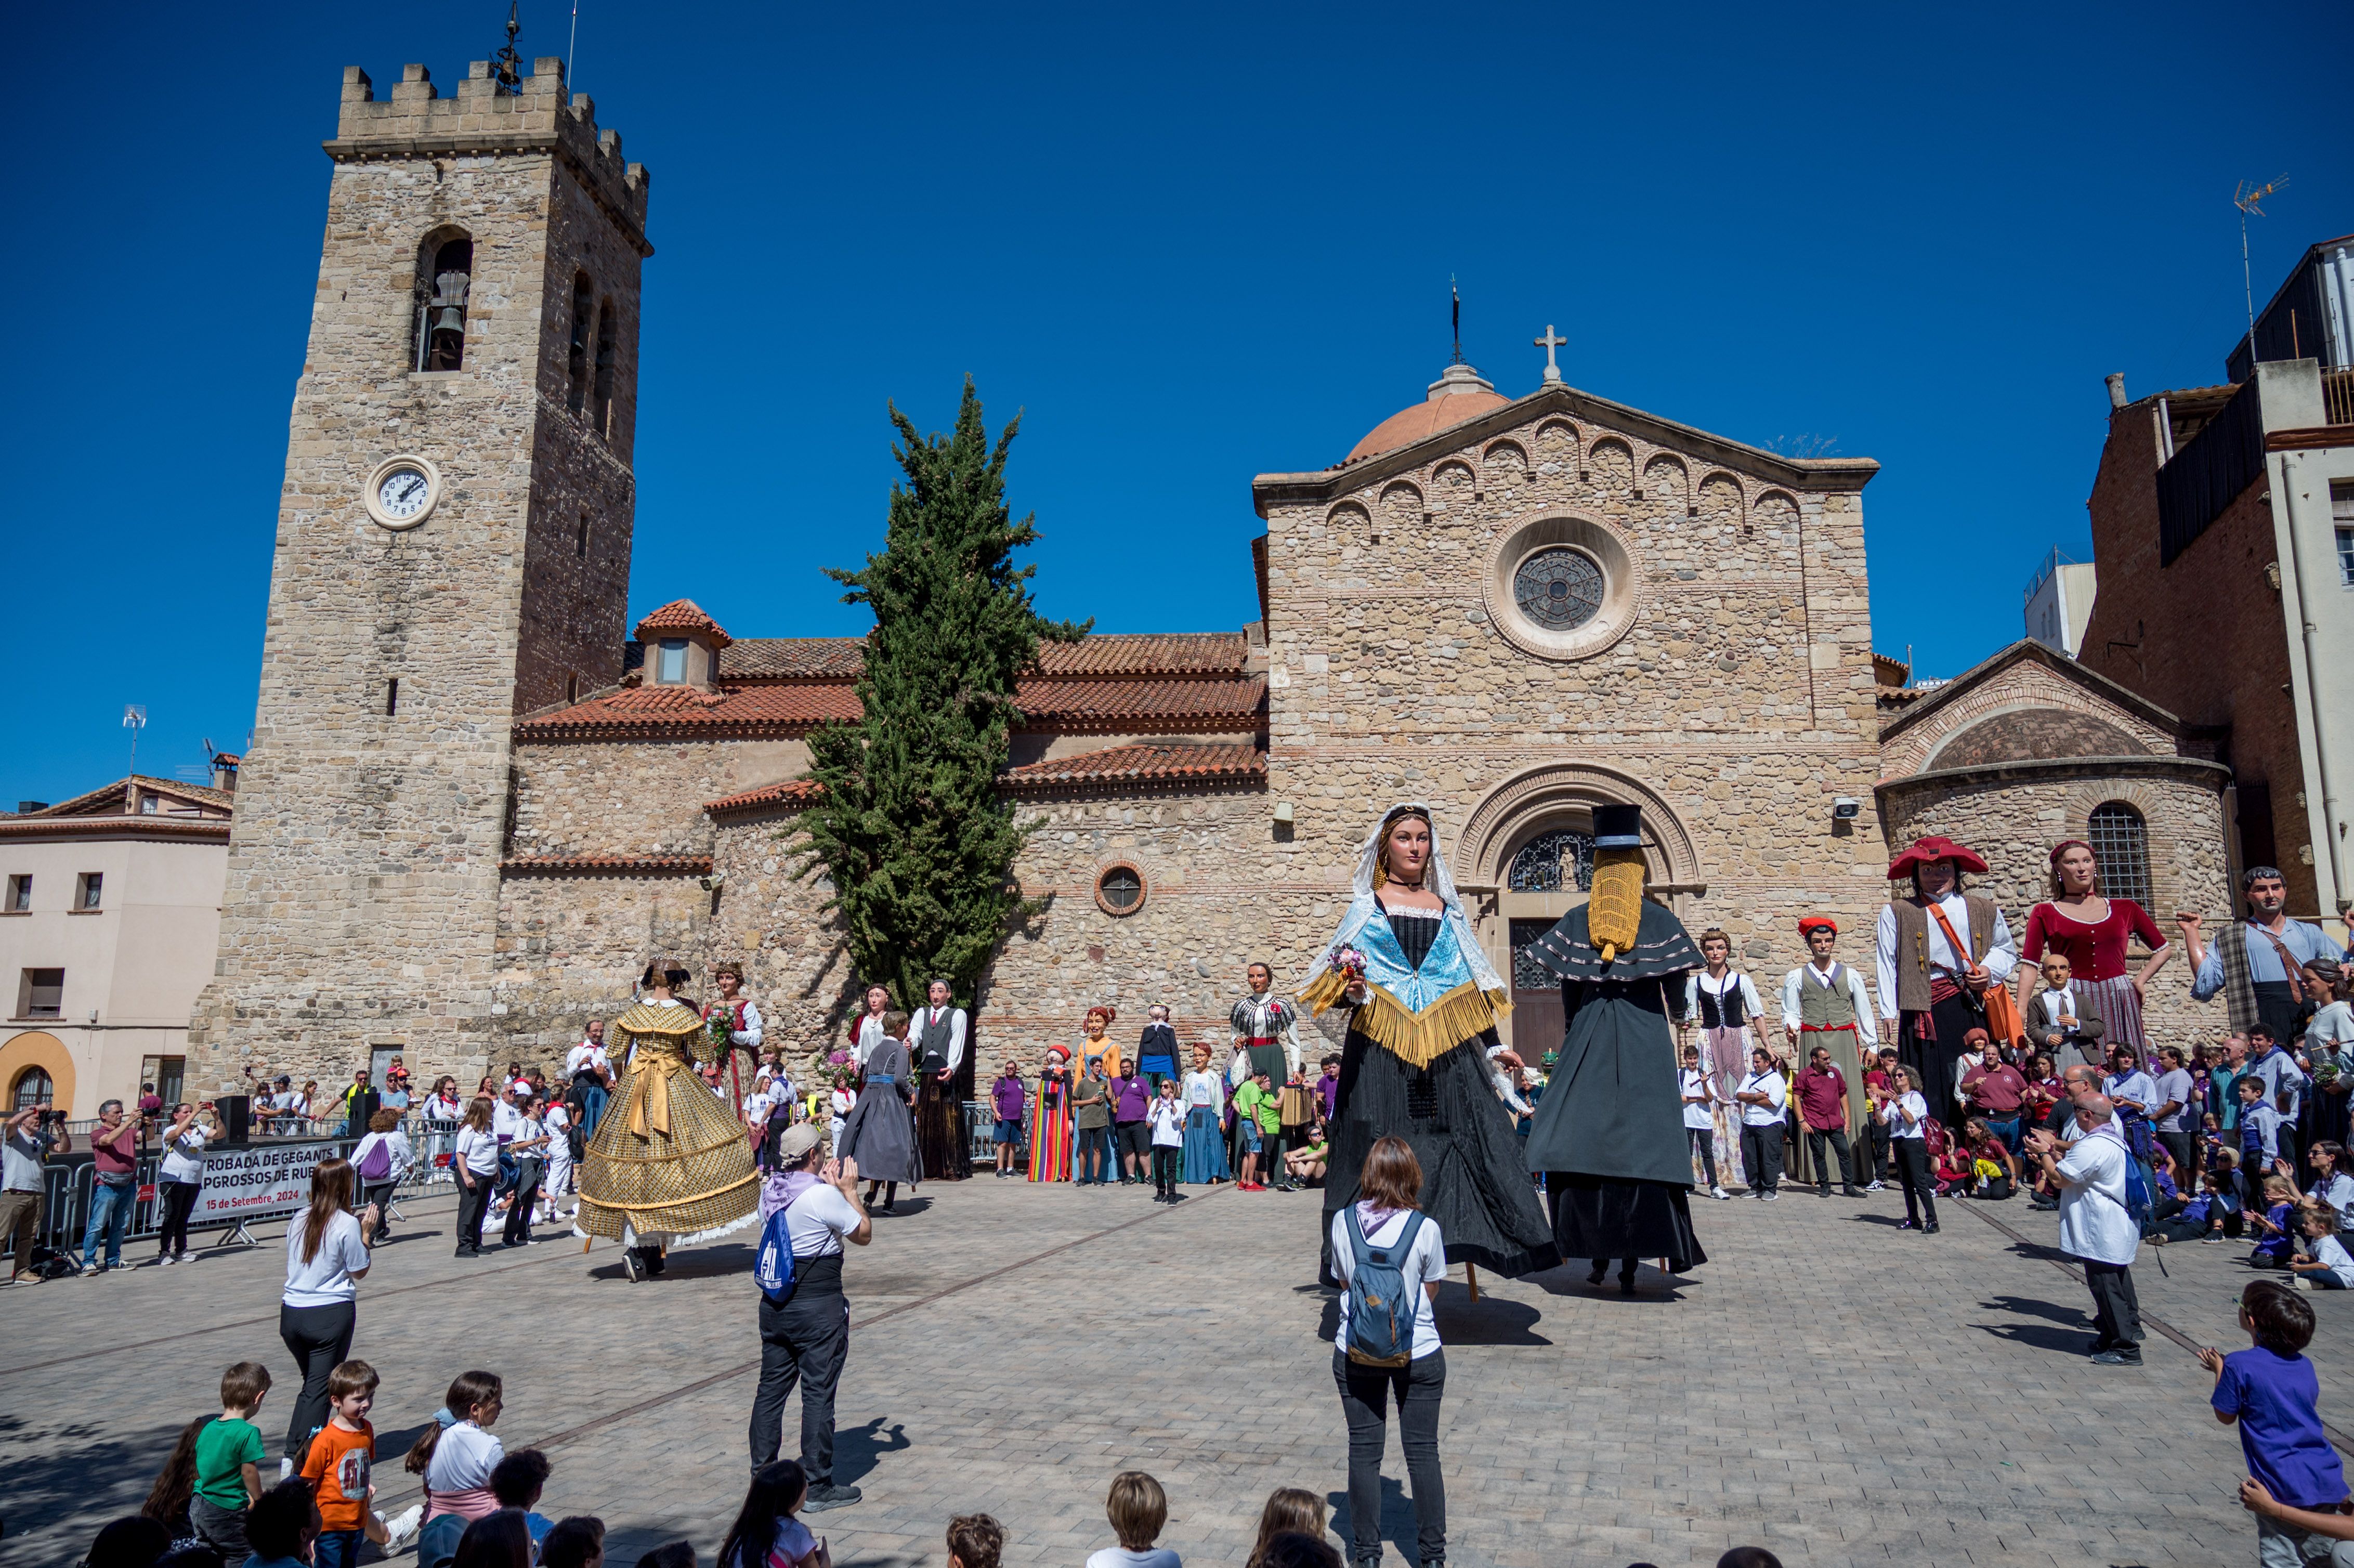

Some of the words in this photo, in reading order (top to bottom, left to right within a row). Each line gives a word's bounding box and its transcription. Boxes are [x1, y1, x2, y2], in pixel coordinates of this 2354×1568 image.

[396, 474, 401, 484] 11
[263, 1154, 279, 1167] DE
[281, 1148, 333, 1165] GEGANTS
[200, 1171, 271, 1190] PGROSSOS
[274, 1169, 289, 1182] DE
[292, 1167, 315, 1180] RUB
[206, 1199, 216, 1210] 15
[219, 1198, 229, 1209] de
[231, 1195, 274, 1207] Setembre,
[277, 1190, 298, 1201] 2024
